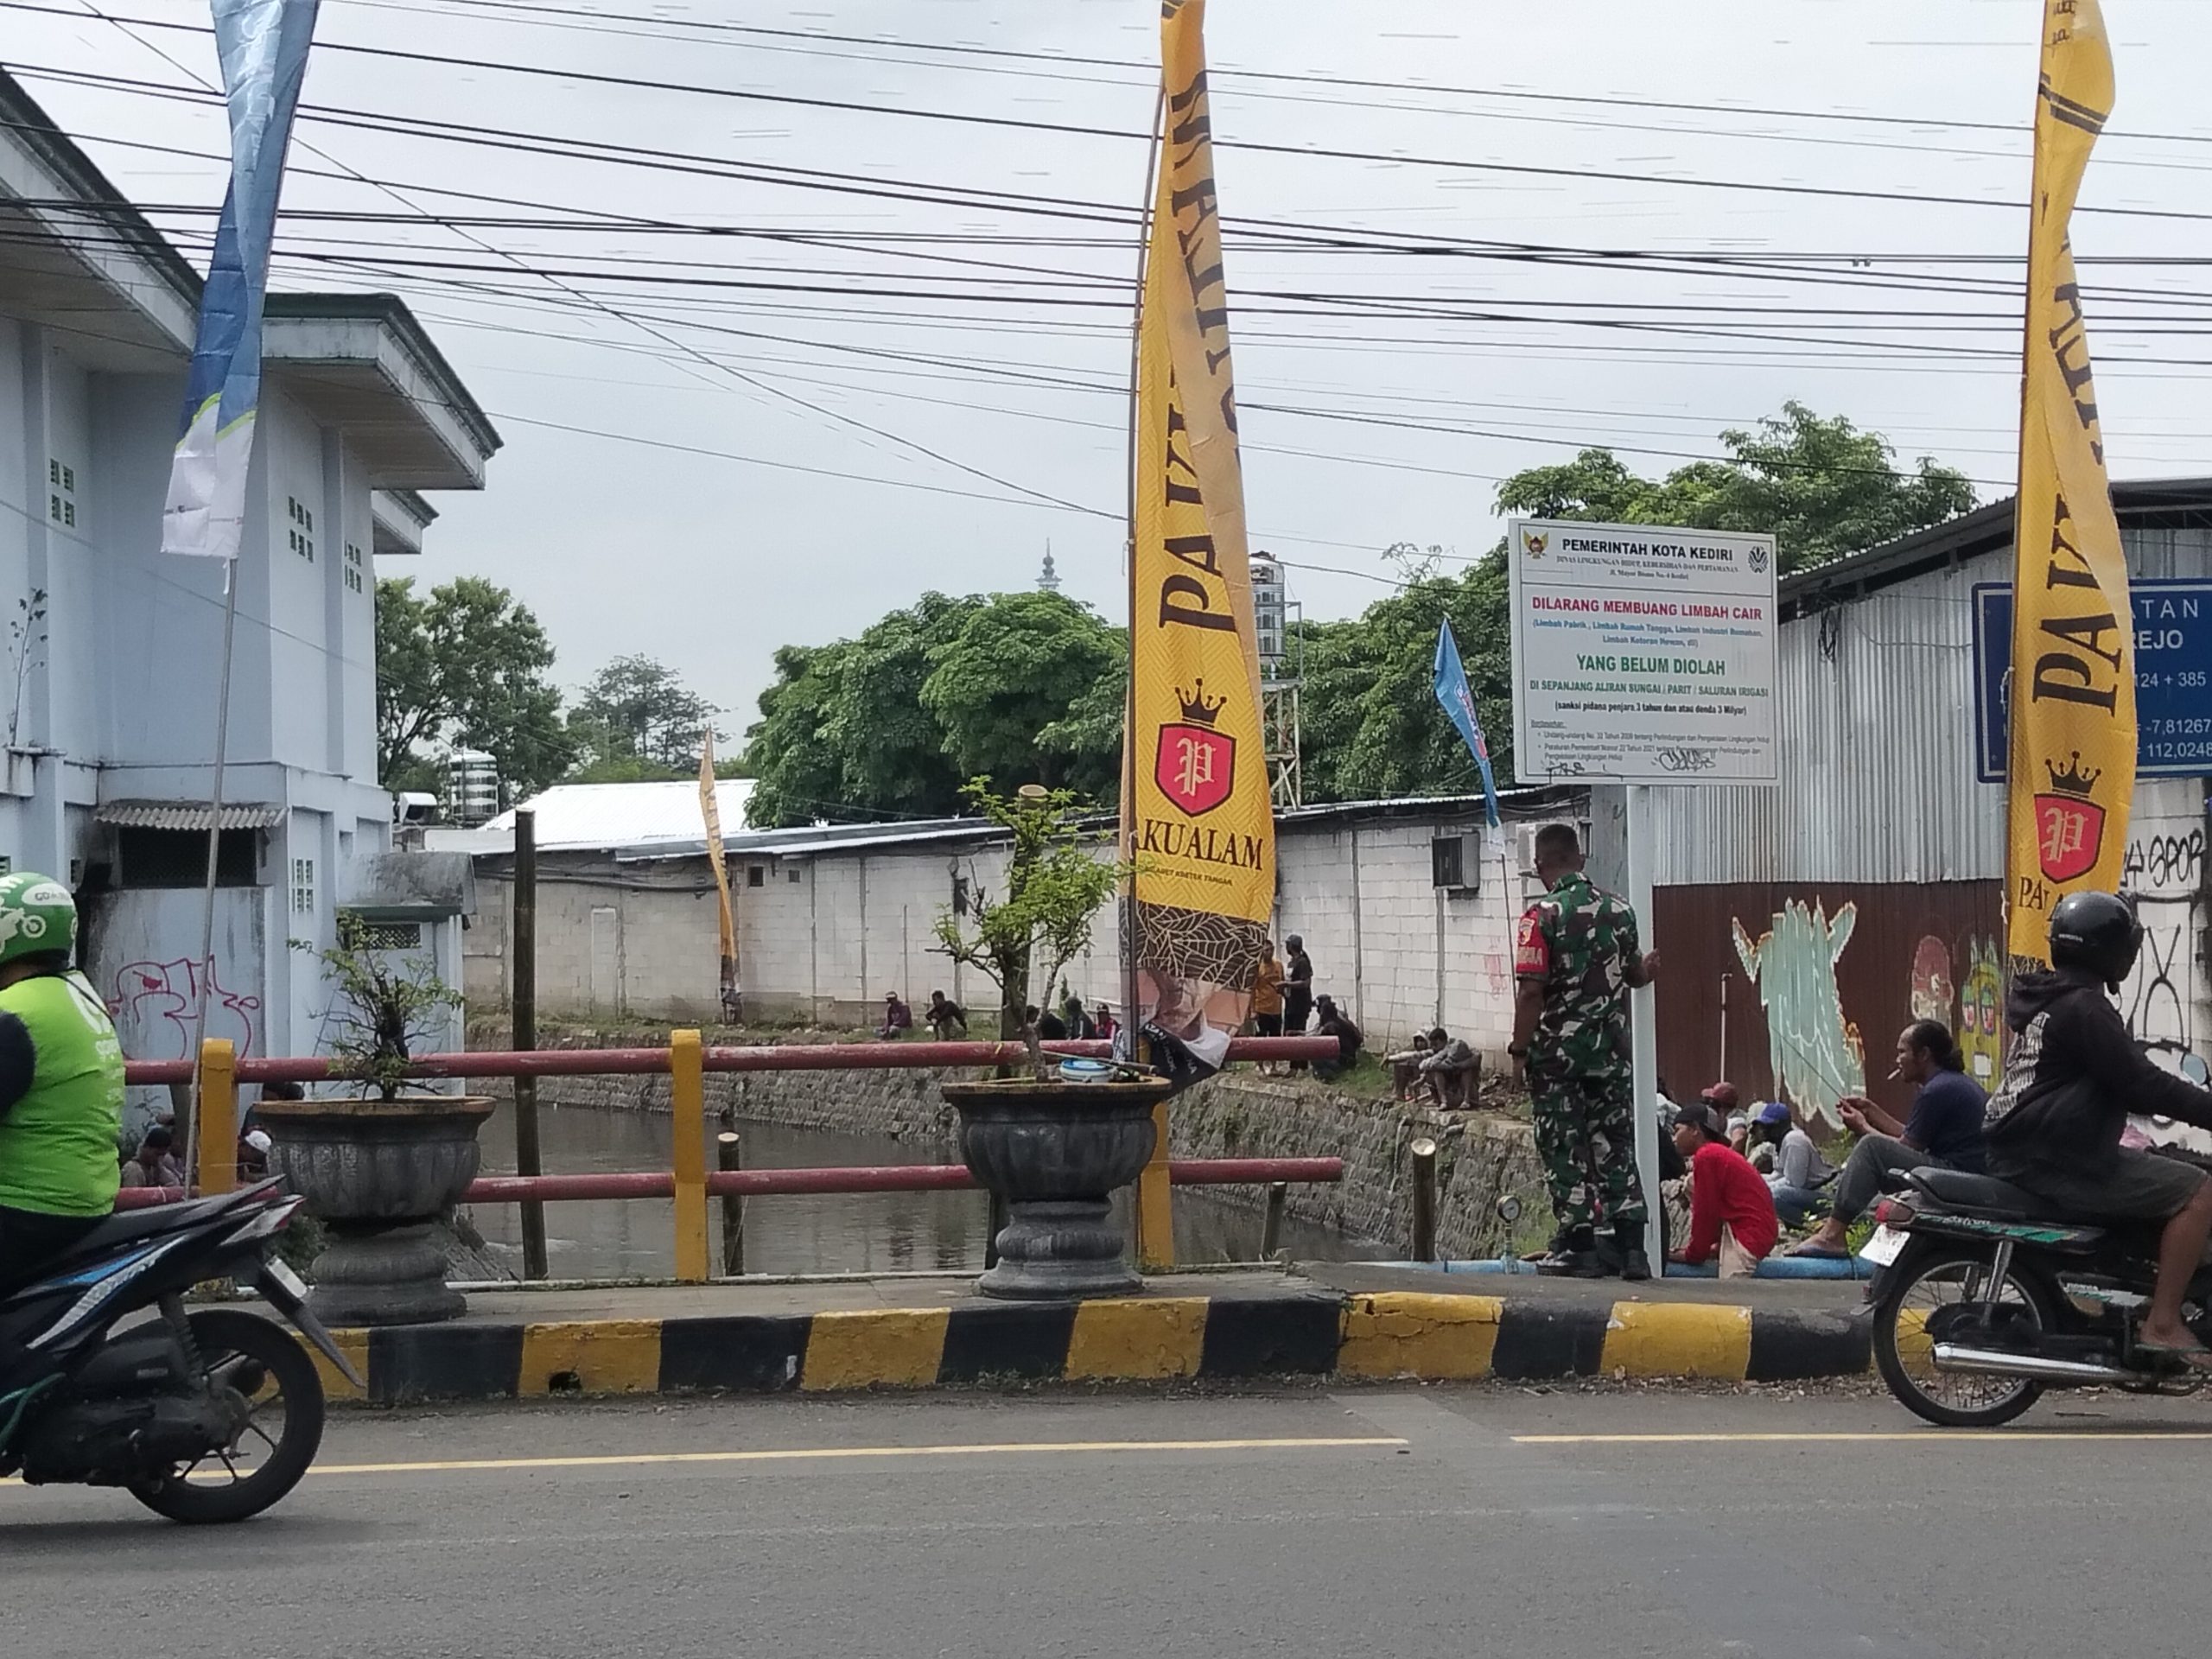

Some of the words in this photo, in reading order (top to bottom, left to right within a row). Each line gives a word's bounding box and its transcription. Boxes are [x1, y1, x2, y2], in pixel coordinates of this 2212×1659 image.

[1562, 538, 1647, 556] PEMERINTAH
[1651, 543, 1687, 558] KOTA
[1690, 546, 1733, 561] KEDIRI
[1532, 596, 1599, 612] DILARANG
[1603, 600, 1677, 616] MEMBUANG
[1681, 604, 1729, 619] LIMBAH
[1732, 607, 1763, 620] CAIR
[2133, 598, 2199, 620] TAN
[1602, 634, 1629, 644] Limbah
[1576, 653, 1617, 671] YANG
[1620, 656, 1669, 674] BELUM
[1673, 658, 1726, 677] DIOLAH
[1529, 679, 1539, 690] DI
[1541, 679, 1593, 691] SEPANJANG
[1595, 682, 1627, 692] ALIRAN
[1628, 683, 1662, 694] SUNGAI
[1668, 684, 1692, 695] PARIT
[1699, 685, 1737, 696] SALURAN
[1738, 686, 1769, 697] IRIGASI
[2177, 671, 2206, 688] 385
[1554, 700, 1581, 712] (sanksi
[1582, 701, 1607, 712] pidana
[1608, 702, 1634, 713] penjara
[1643, 702, 1662, 712] tahun
[1663, 703, 1677, 713] dan
[1678, 704, 1694, 713] atau
[1695, 704, 1716, 714] denda
[1137, 818, 1264, 872] KUALAM
